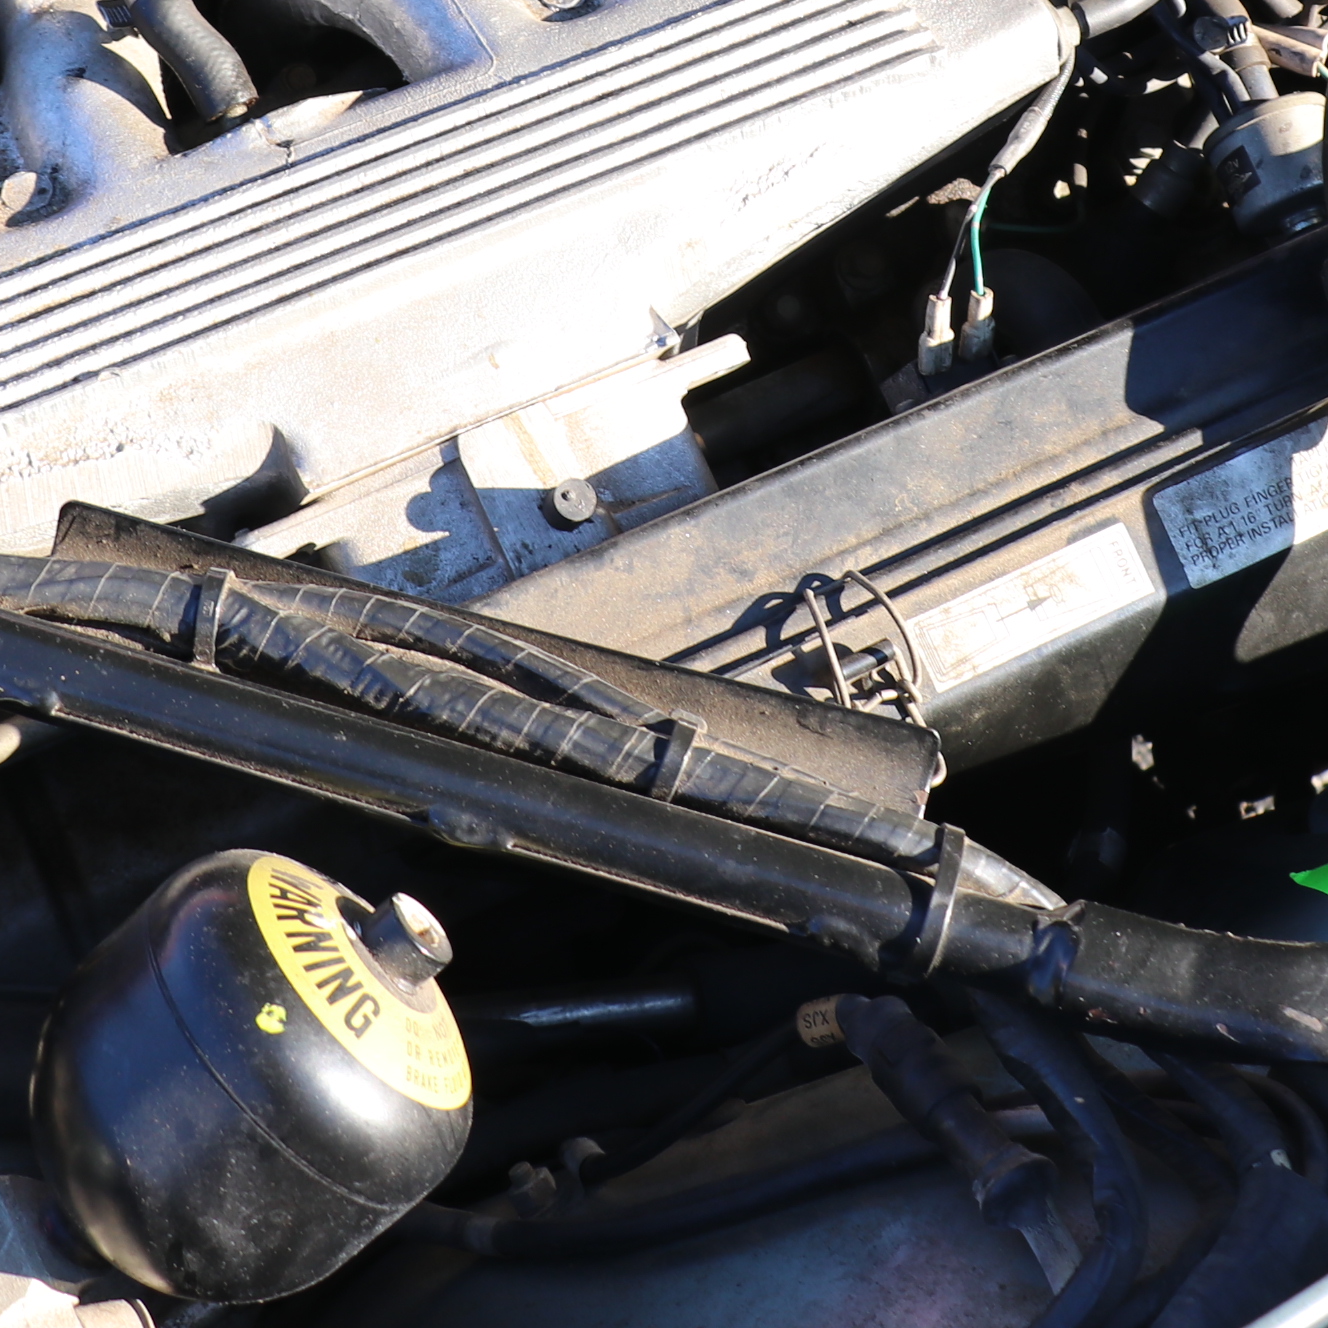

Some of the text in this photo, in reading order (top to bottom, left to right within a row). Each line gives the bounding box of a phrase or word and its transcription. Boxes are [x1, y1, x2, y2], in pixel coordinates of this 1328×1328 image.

[1201, 502, 1241, 527] PLUG
[1242, 478, 1295, 508] FINGER
[1184, 532, 1213, 552] FOR
[1190, 534, 1245, 564] PROPER
[1107, 540, 1136, 585] FRONT
[268, 868, 381, 1040] WARNING
[405, 1016, 420, 1036] DO
[803, 1009, 829, 1029] XJS
[406, 1041, 422, 1060] OR
[406, 1066, 440, 1093] BRAKE
